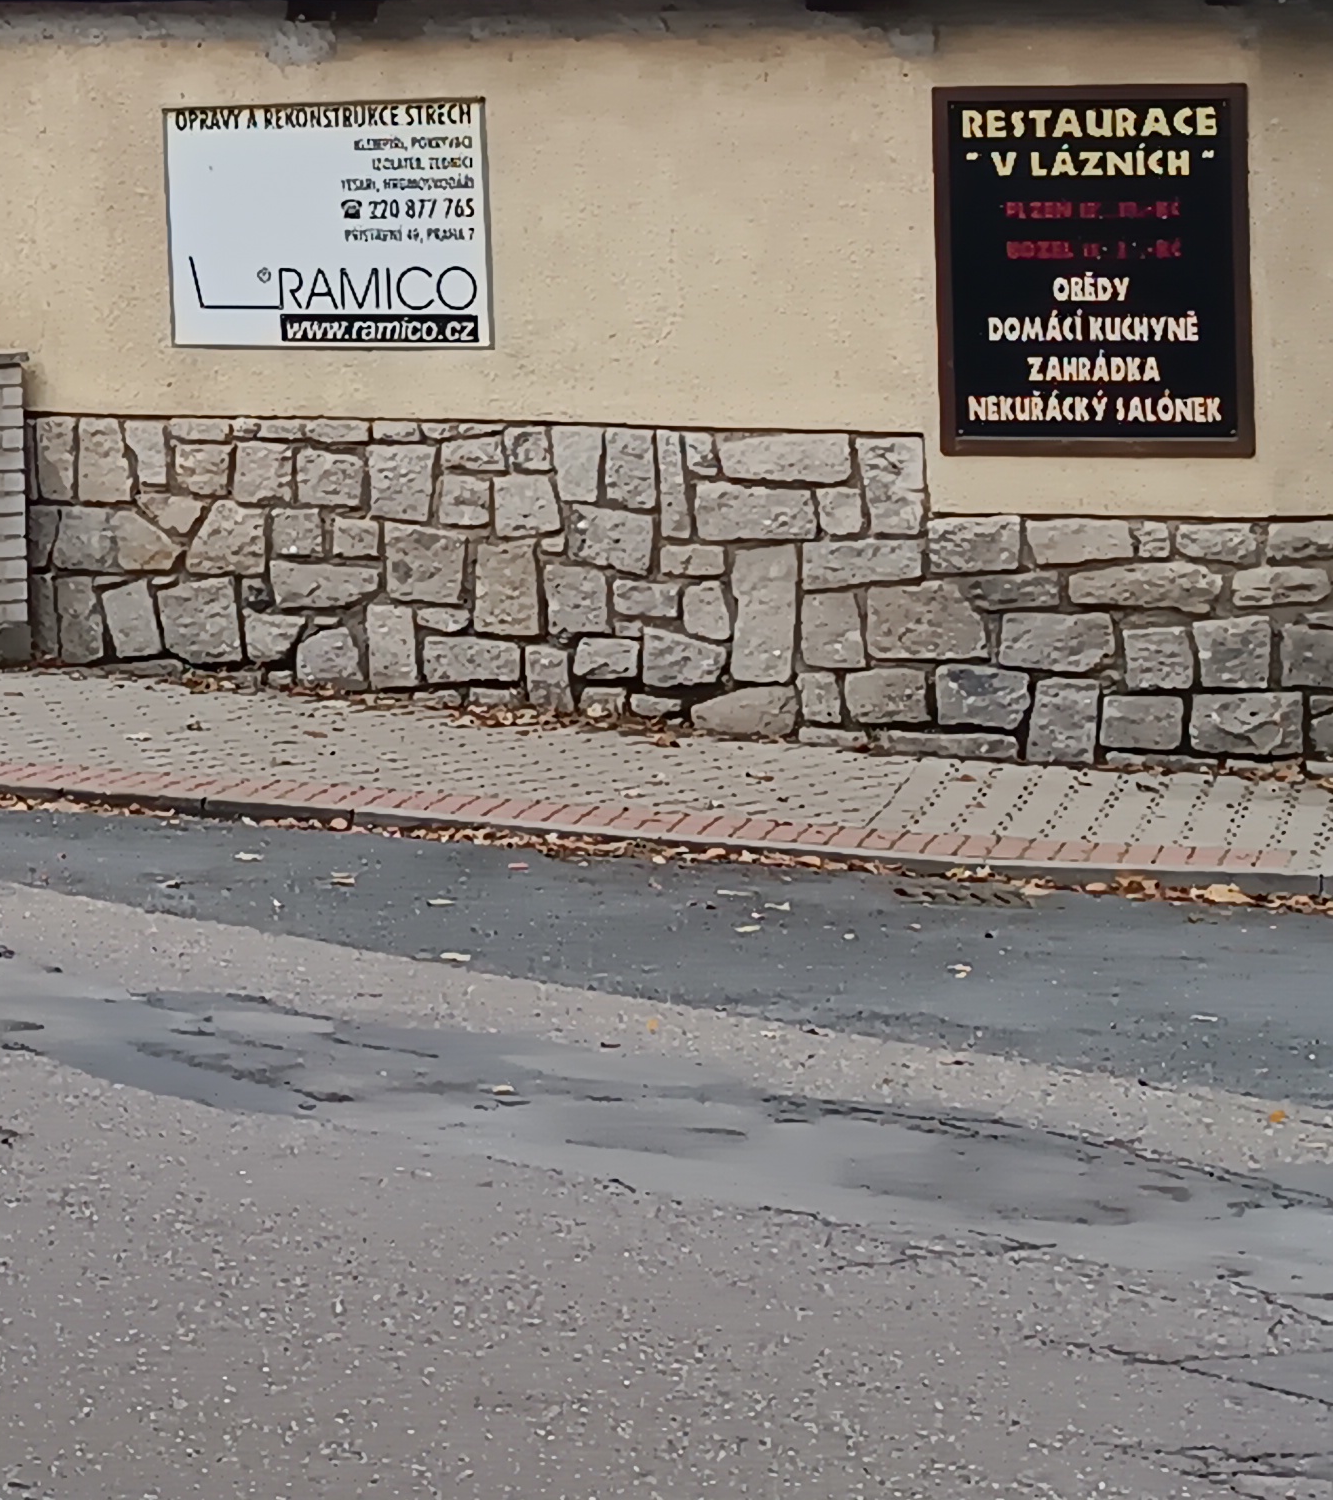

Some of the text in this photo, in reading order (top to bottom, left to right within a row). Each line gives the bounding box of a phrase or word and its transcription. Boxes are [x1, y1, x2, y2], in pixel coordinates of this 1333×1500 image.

[175, 110, 242, 131] OPRAVY
[247, 108, 258, 129] A
[264, 104, 400, 129] REKONSTRUKCE
[961, 108, 1218, 138] RESTAURACE
[990, 151, 1017, 176] V
[1030, 143, 1190, 176] LÁZNÍCH
[369, 197, 475, 219] 220 877 765
[279, 266, 477, 311] RAMICO
[1053, 271, 1130, 301] OBĚDY
[286, 317, 475, 341] www.ramico.cz
[988, 309, 1199, 342] DOMÁCÍ KUCHYNĚ
[1027, 349, 1161, 382] ZAHRÁDKA
[968, 388, 1222, 422] NEKUŘÁCKÝ SALÓNEK
